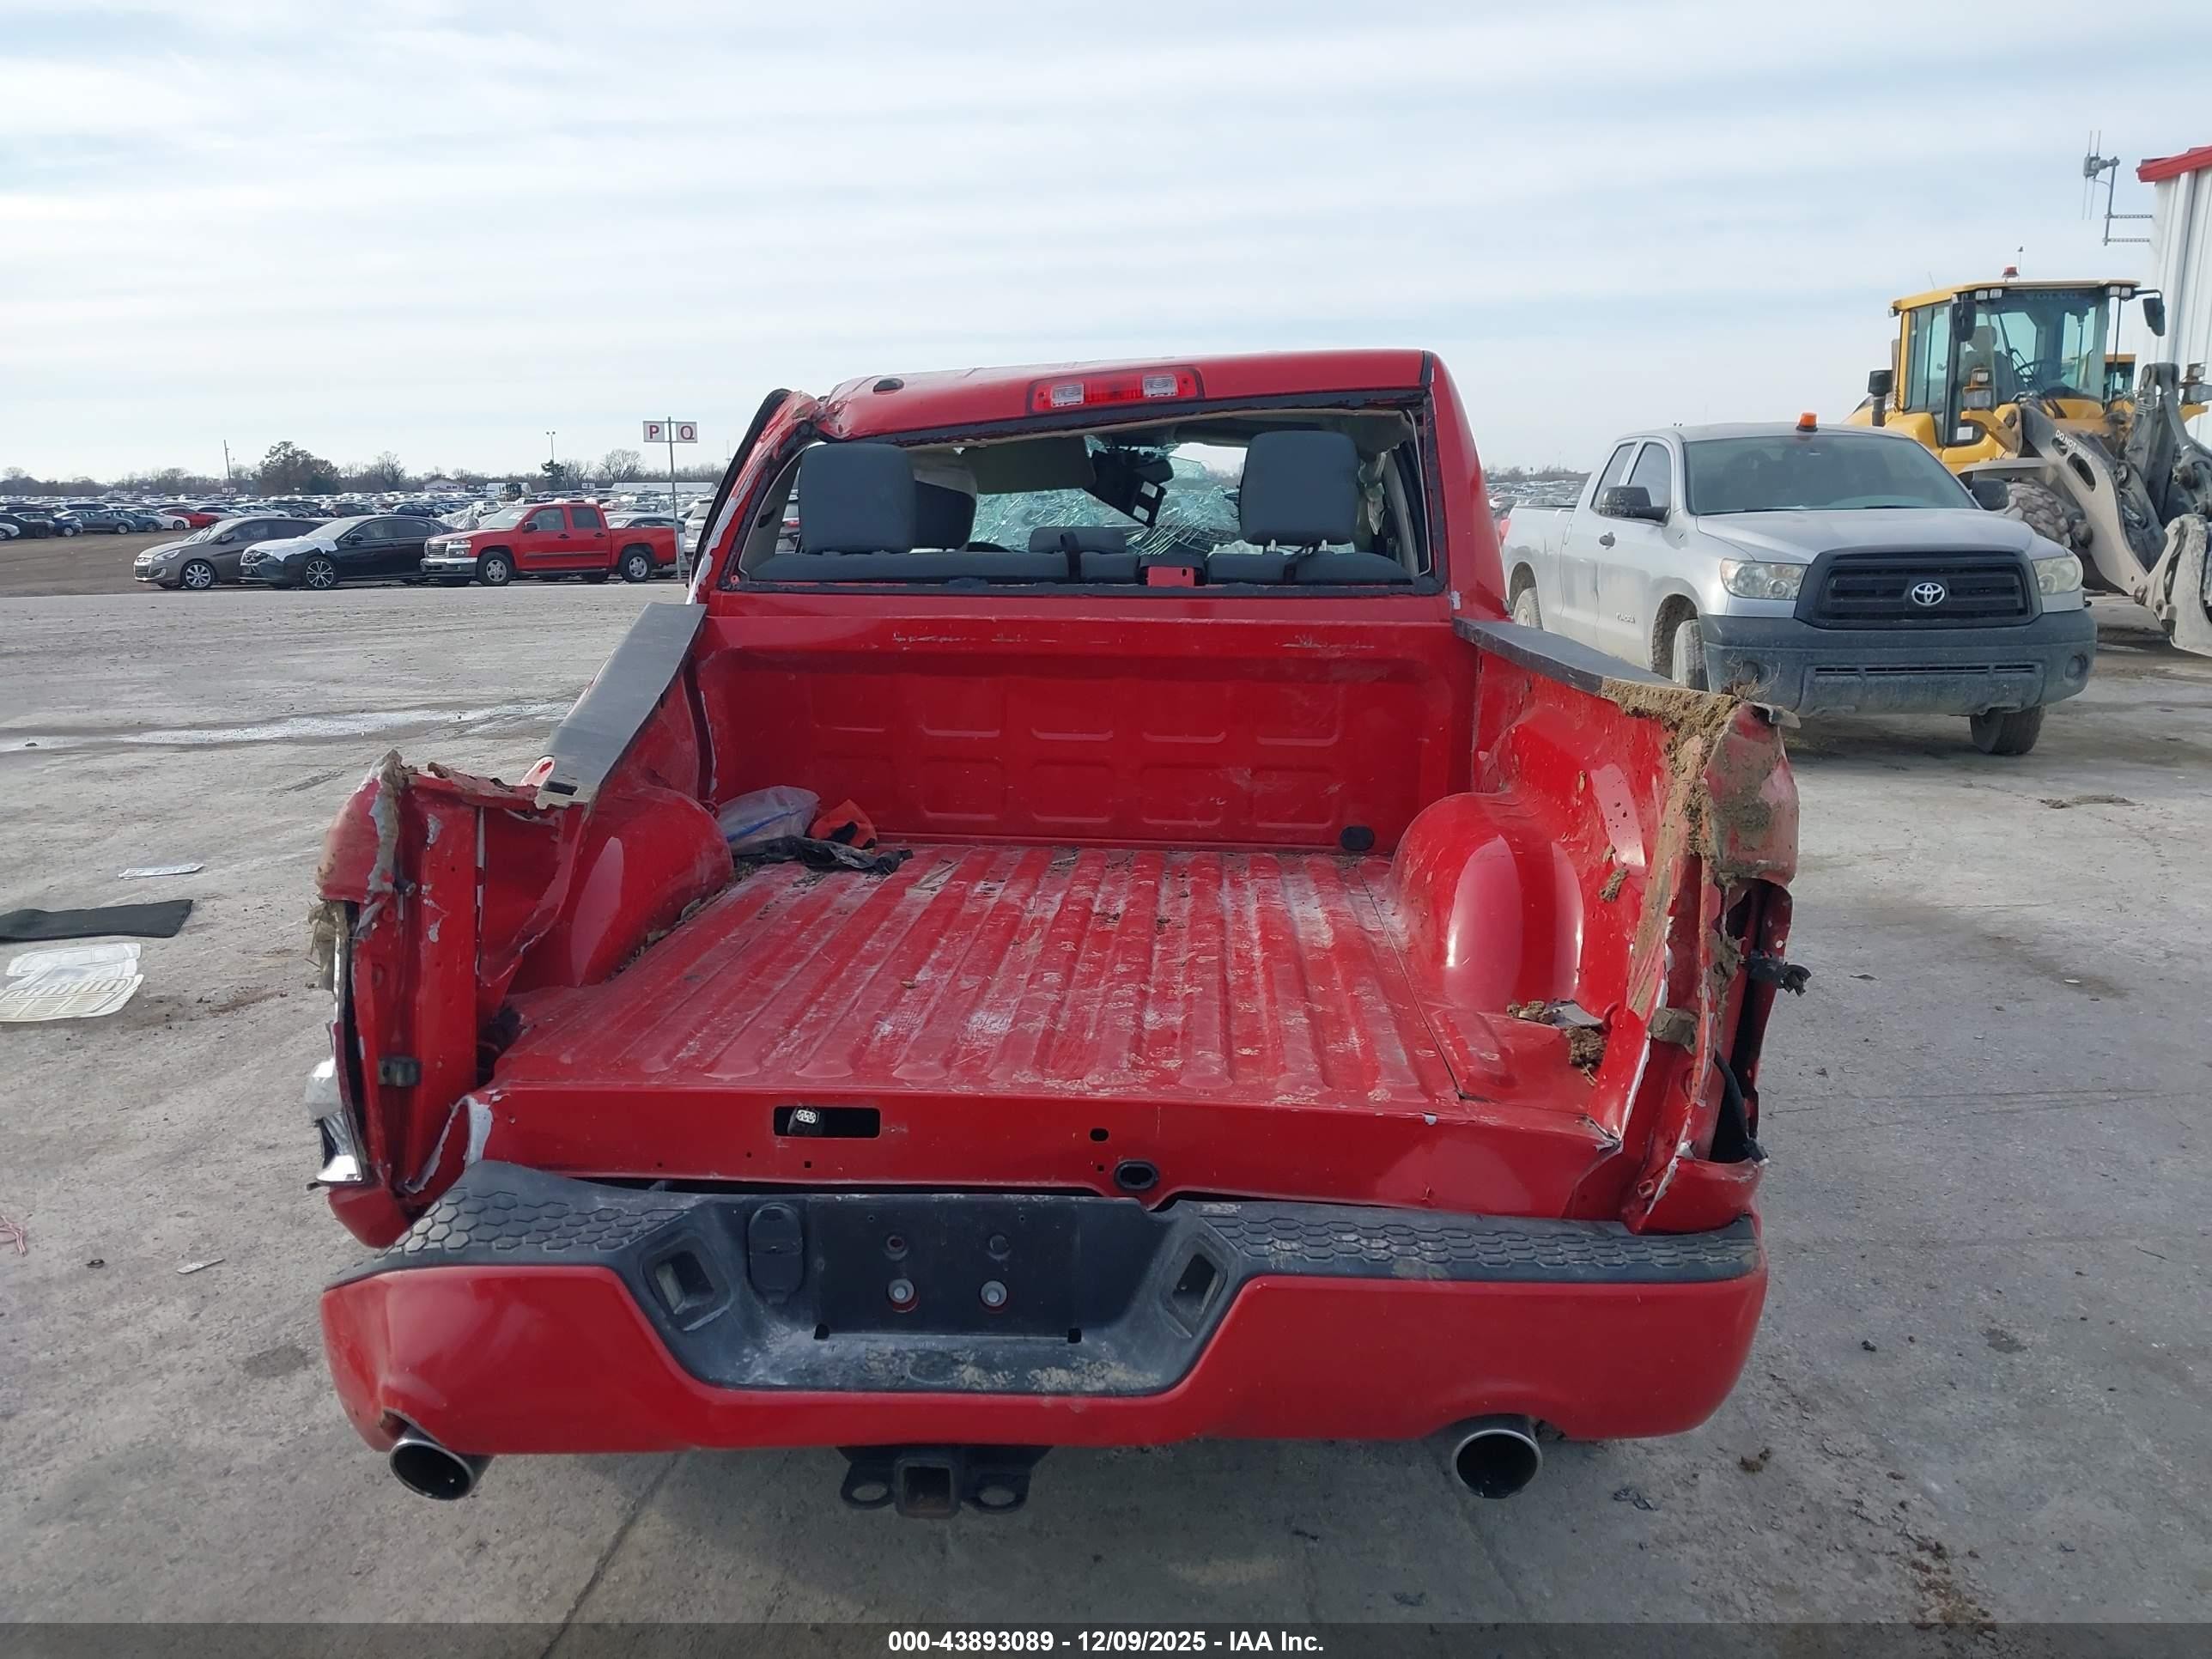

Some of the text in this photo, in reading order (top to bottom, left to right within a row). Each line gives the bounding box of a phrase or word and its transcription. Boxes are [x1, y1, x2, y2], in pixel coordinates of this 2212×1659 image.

[649, 425, 694, 440] P Q
[2055, 429, 2065, 441] DO
[2064, 436, 2076, 450] NOT
